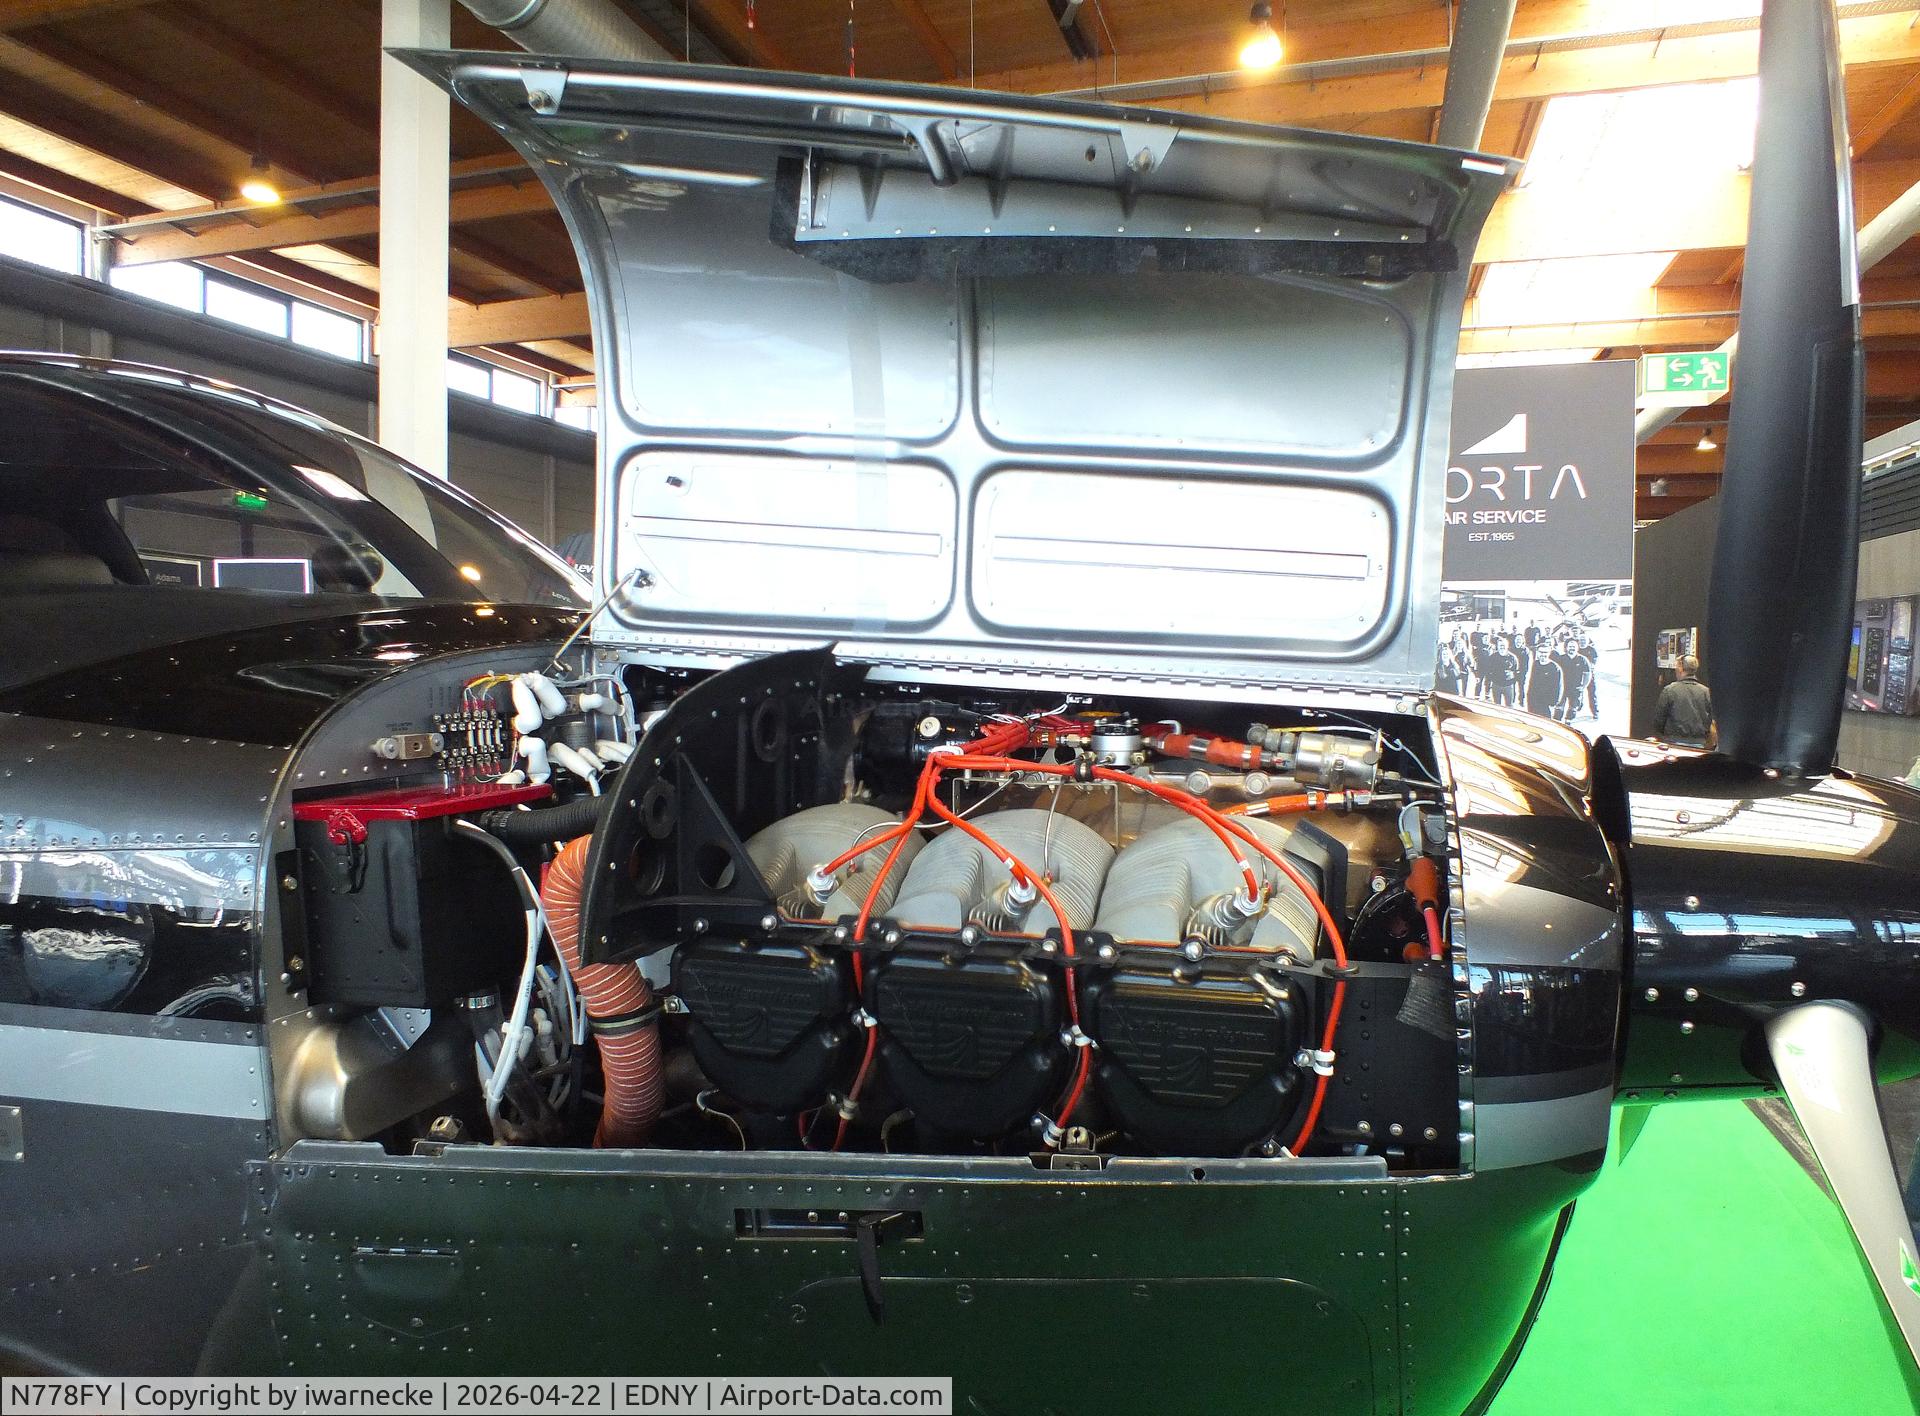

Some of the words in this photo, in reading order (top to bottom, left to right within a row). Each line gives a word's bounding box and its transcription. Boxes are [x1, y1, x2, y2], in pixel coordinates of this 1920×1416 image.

[1445, 464, 1587, 504] ORTA
[1443, 511, 1468, 525] AIR
[1472, 509, 1547, 525] SERVICE
[1468, 532, 1516, 542] EST.1965
